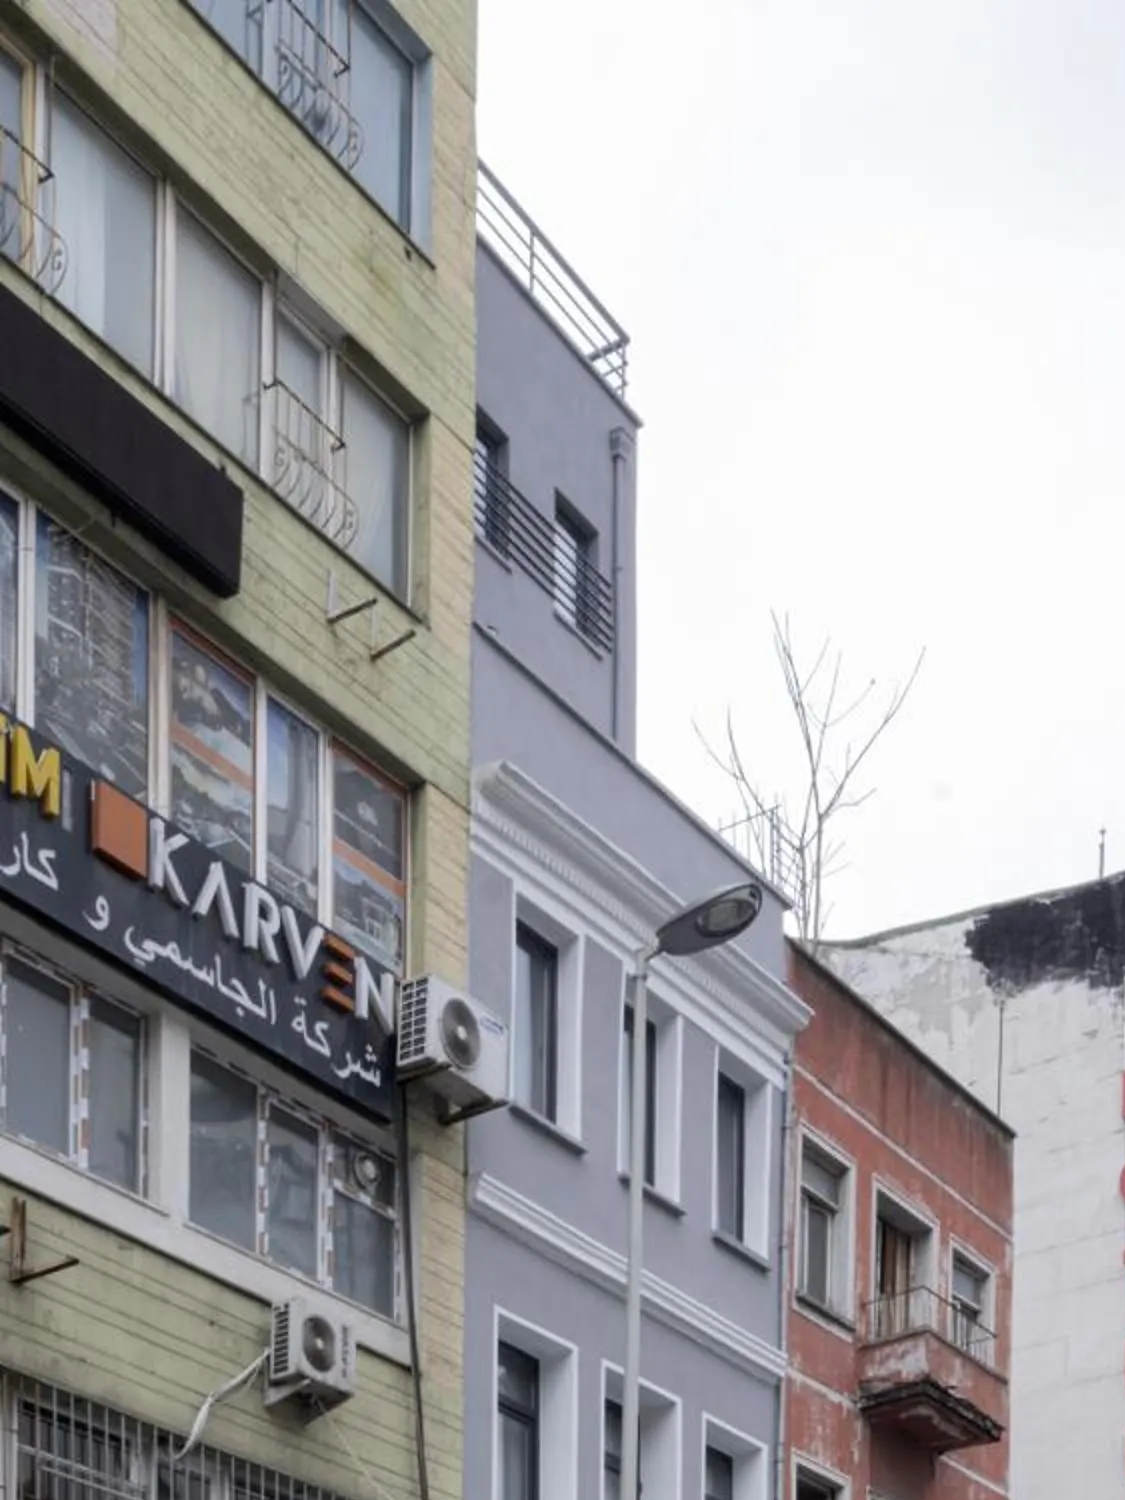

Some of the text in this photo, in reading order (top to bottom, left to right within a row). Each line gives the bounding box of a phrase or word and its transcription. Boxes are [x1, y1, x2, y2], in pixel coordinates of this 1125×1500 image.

[82, 895, 110, 931] و
[147, 816, 395, 1036] KARVEN
[124, 926, 276, 1026] الجاسمي
